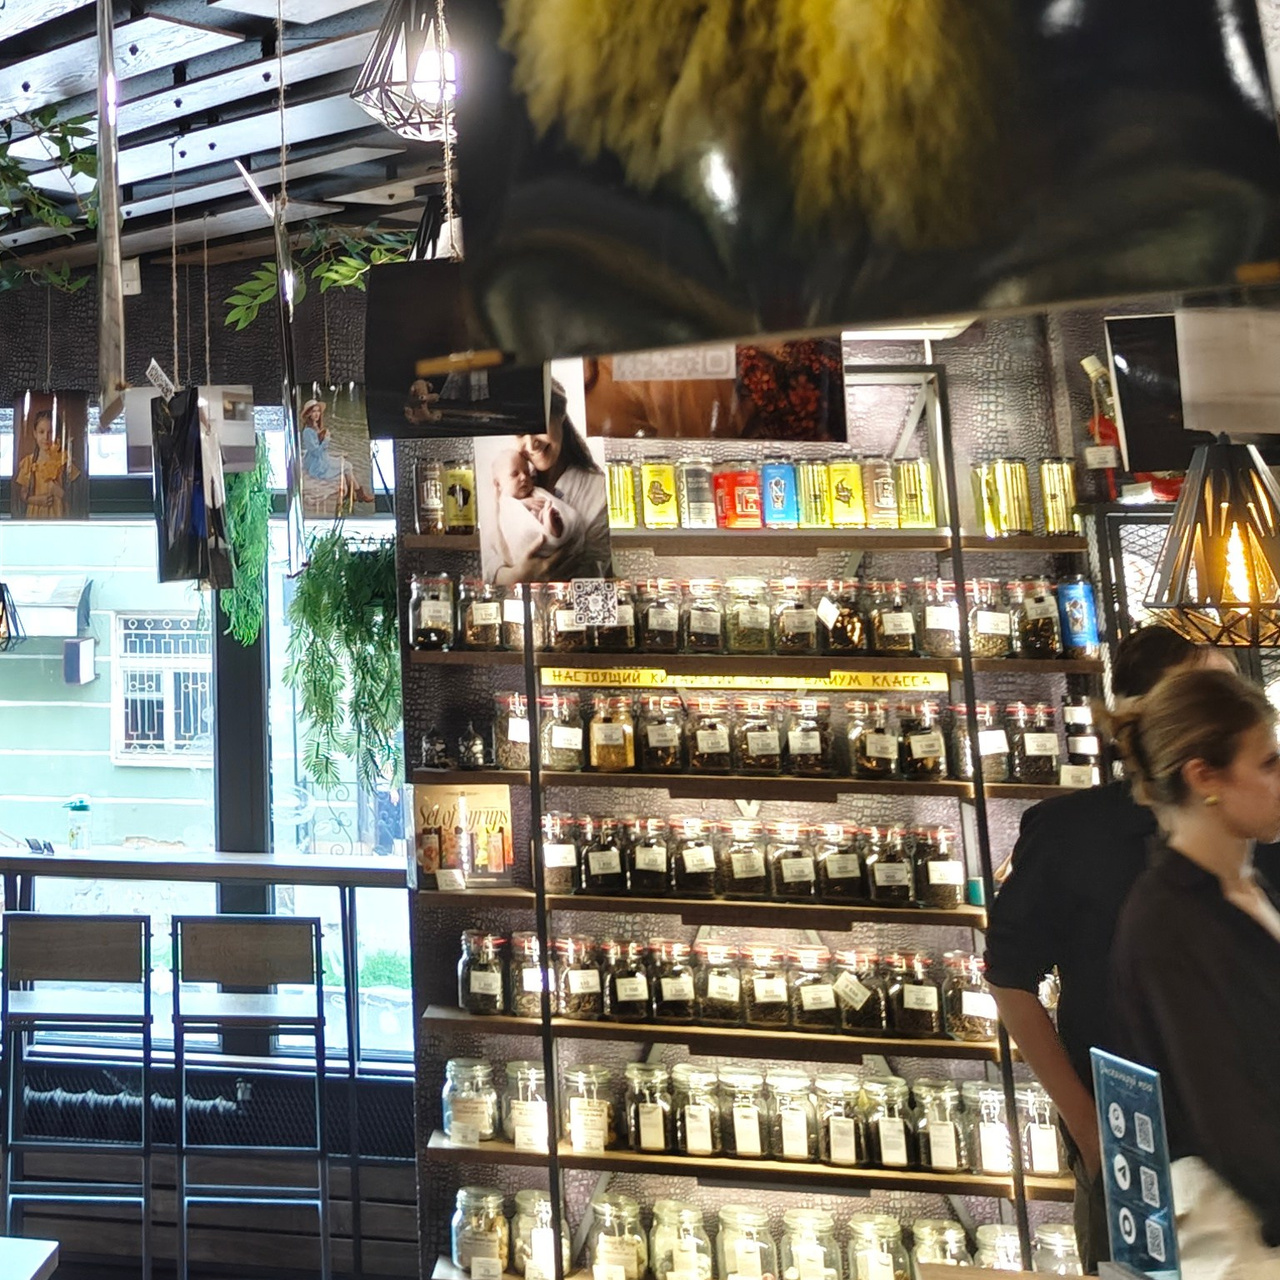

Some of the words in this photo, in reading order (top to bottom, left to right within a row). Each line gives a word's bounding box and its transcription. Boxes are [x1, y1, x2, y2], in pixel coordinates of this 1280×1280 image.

[552, 669, 641, 684] НАСТОЯЩИЙ
[871, 674, 931, 687] КЛАССА
[420, 805, 440, 826] Set
[442, 803, 457, 831] of
[462, 810, 508, 832] yrups
